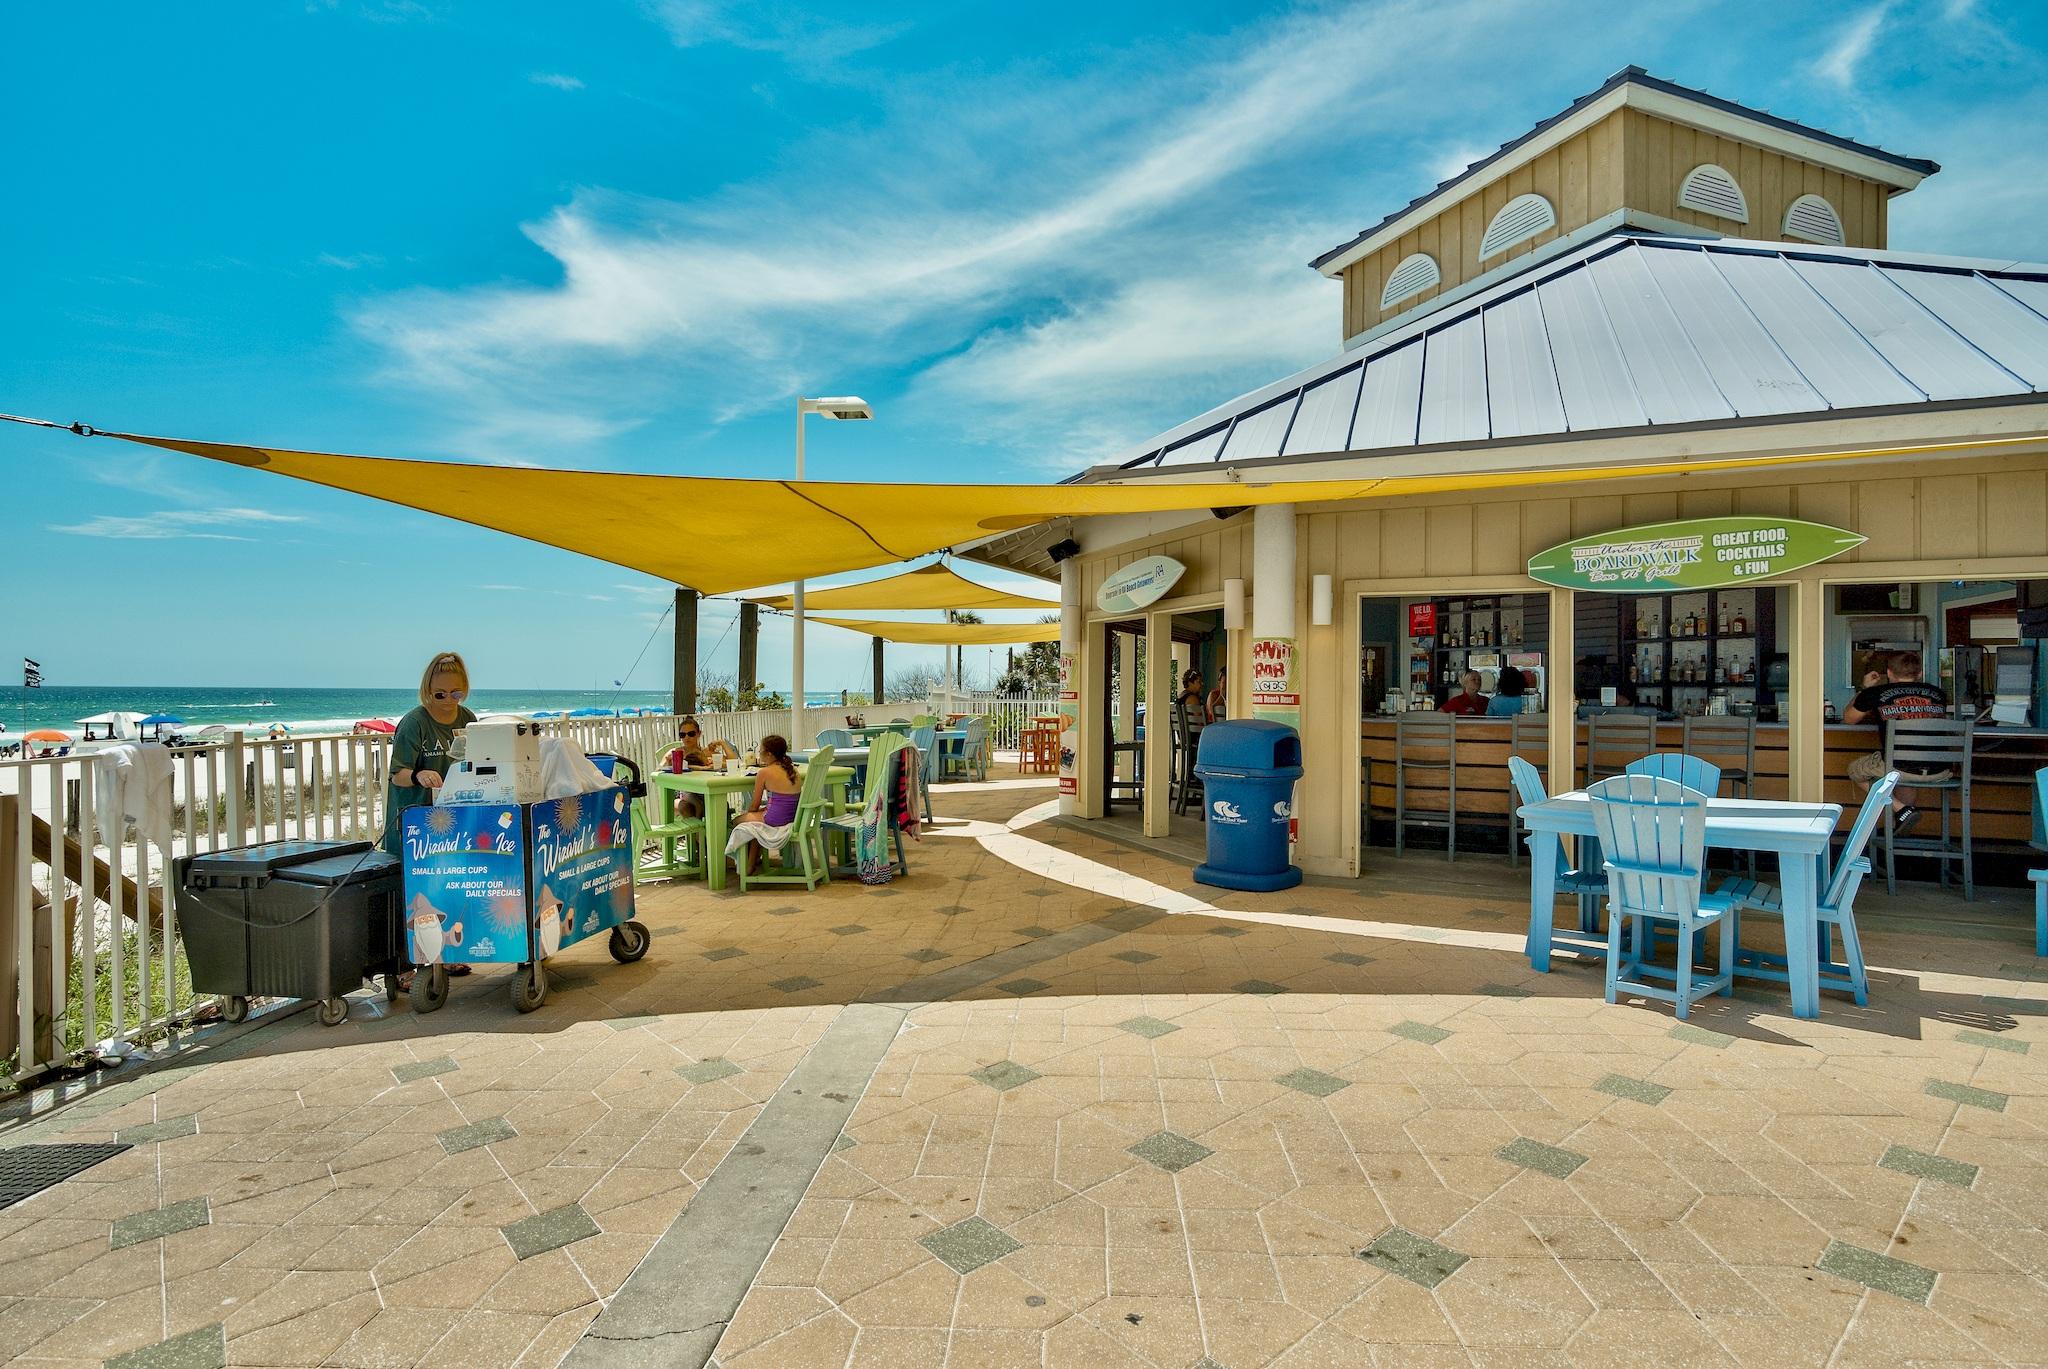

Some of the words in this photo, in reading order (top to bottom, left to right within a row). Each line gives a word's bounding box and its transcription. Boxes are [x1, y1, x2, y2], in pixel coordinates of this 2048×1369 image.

[1712, 531, 1751, 547] GREAT
[1752, 527, 1789, 544] FOOD,
[1600, 542, 1644, 555] Under
[1650, 540, 1672, 551] the
[1716, 543, 1786, 562] COCKTAILS
[1575, 548, 1701, 572] BOARDWALK
[1733, 564, 1743, 576] &
[1745, 560, 1769, 575] FUN
[1591, 570, 1618, 582] Bar
[1646, 565, 1681, 582] Grill
[1253, 680, 1288, 692] ACES
[1881, 705, 1944, 716] HARLEY-DAVIDSON
[407, 825, 420, 837] The
[538, 824, 551, 843] The
[406, 831, 473, 861] Wizard's
[495, 832, 516, 855] Ice
[537, 824, 595, 877] Wizard's
[612, 819, 627, 848] Ice
[412, 866, 435, 876] SMALL
[436, 867, 441, 875] &
[443, 866, 466, 875] LARGE
[467, 865, 488, 874] CUPS
[558, 866, 576, 880] SMALL
[576, 867, 580, 875] &
[580, 861, 597, 873] LARGE
[597, 856, 611, 868] CUPS
[445, 881, 460, 889] ASK
[461, 881, 486, 889] ABOUT
[487, 880, 503, 888] OUR
[581, 880, 592, 891] ASK
[592, 874, 608, 887] ABOUT
[608, 870, 619, 880] OUR
[594, 883, 608, 896] DAILY
[608, 875, 631, 890] SPECIALS
[465, 890, 486, 898] DAILY
[487, 889, 522, 897] SPECIALS
